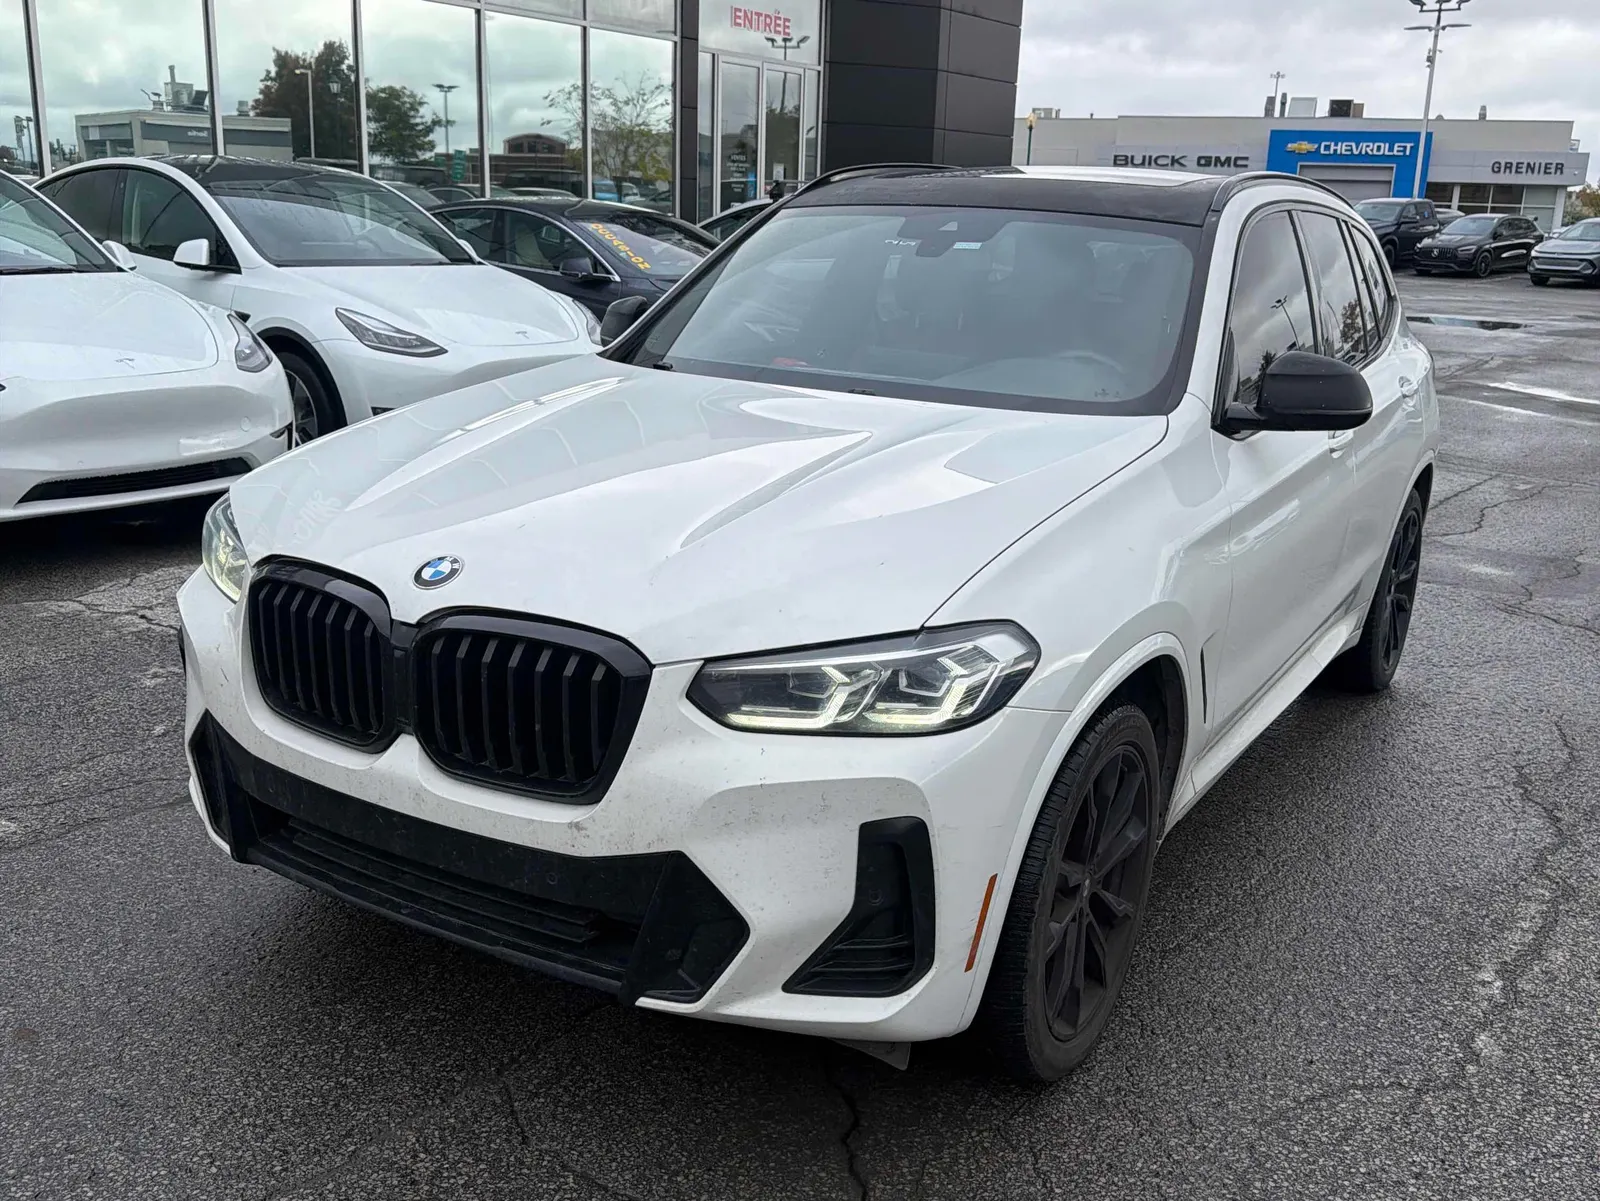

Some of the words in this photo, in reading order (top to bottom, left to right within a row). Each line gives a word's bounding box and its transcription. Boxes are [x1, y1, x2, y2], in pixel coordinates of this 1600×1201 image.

[731, 6, 791, 37] ENTRÉE
[1320, 141, 1414, 156] CHEVROLET
[1113, 154, 1187, 167] BUICK
[1196, 155, 1249, 168] GMC
[1491, 160, 1564, 175] GRENIER
